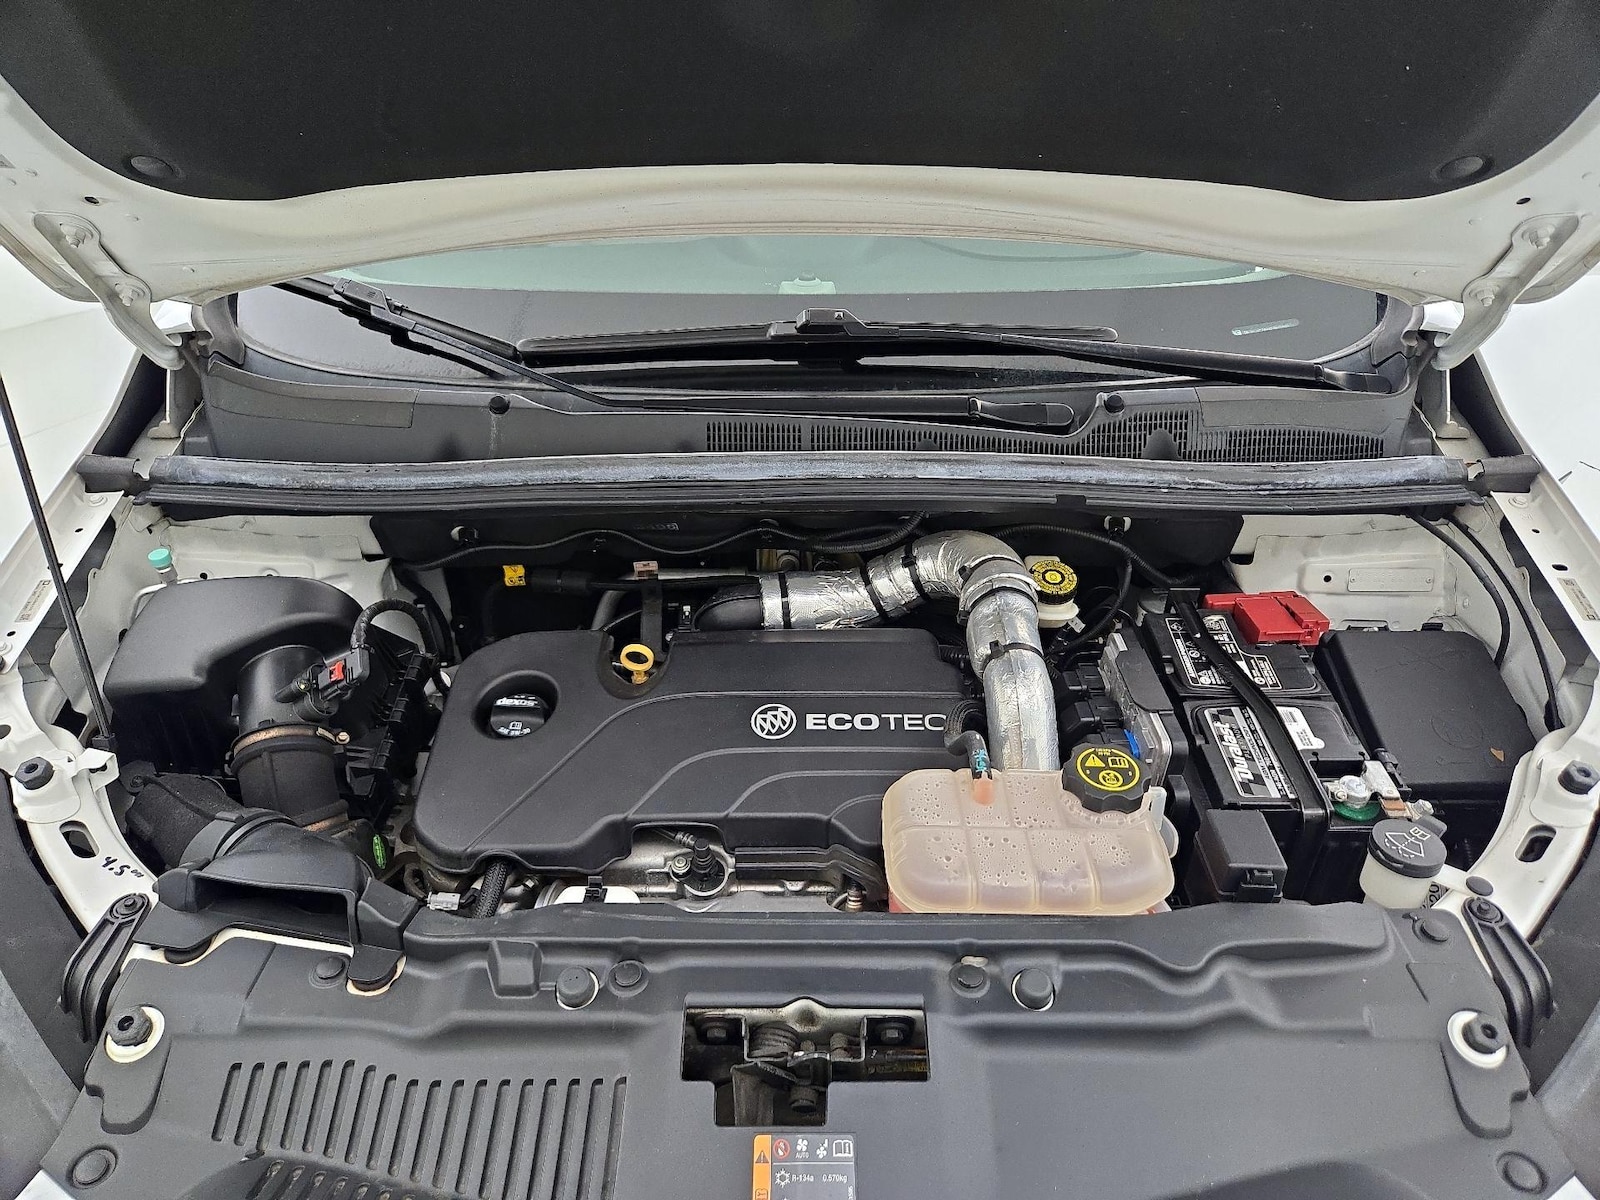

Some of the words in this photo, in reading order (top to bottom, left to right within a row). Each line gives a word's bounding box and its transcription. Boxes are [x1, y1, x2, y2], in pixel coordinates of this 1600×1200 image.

[495, 697, 538, 707] dexos
[805, 713, 947, 731] ECOTEC
[1212, 720, 1255, 782] Duralast
[791, 1174, 814, 1182] R-134a
[822, 1174, 848, 1183] 0.570kg
